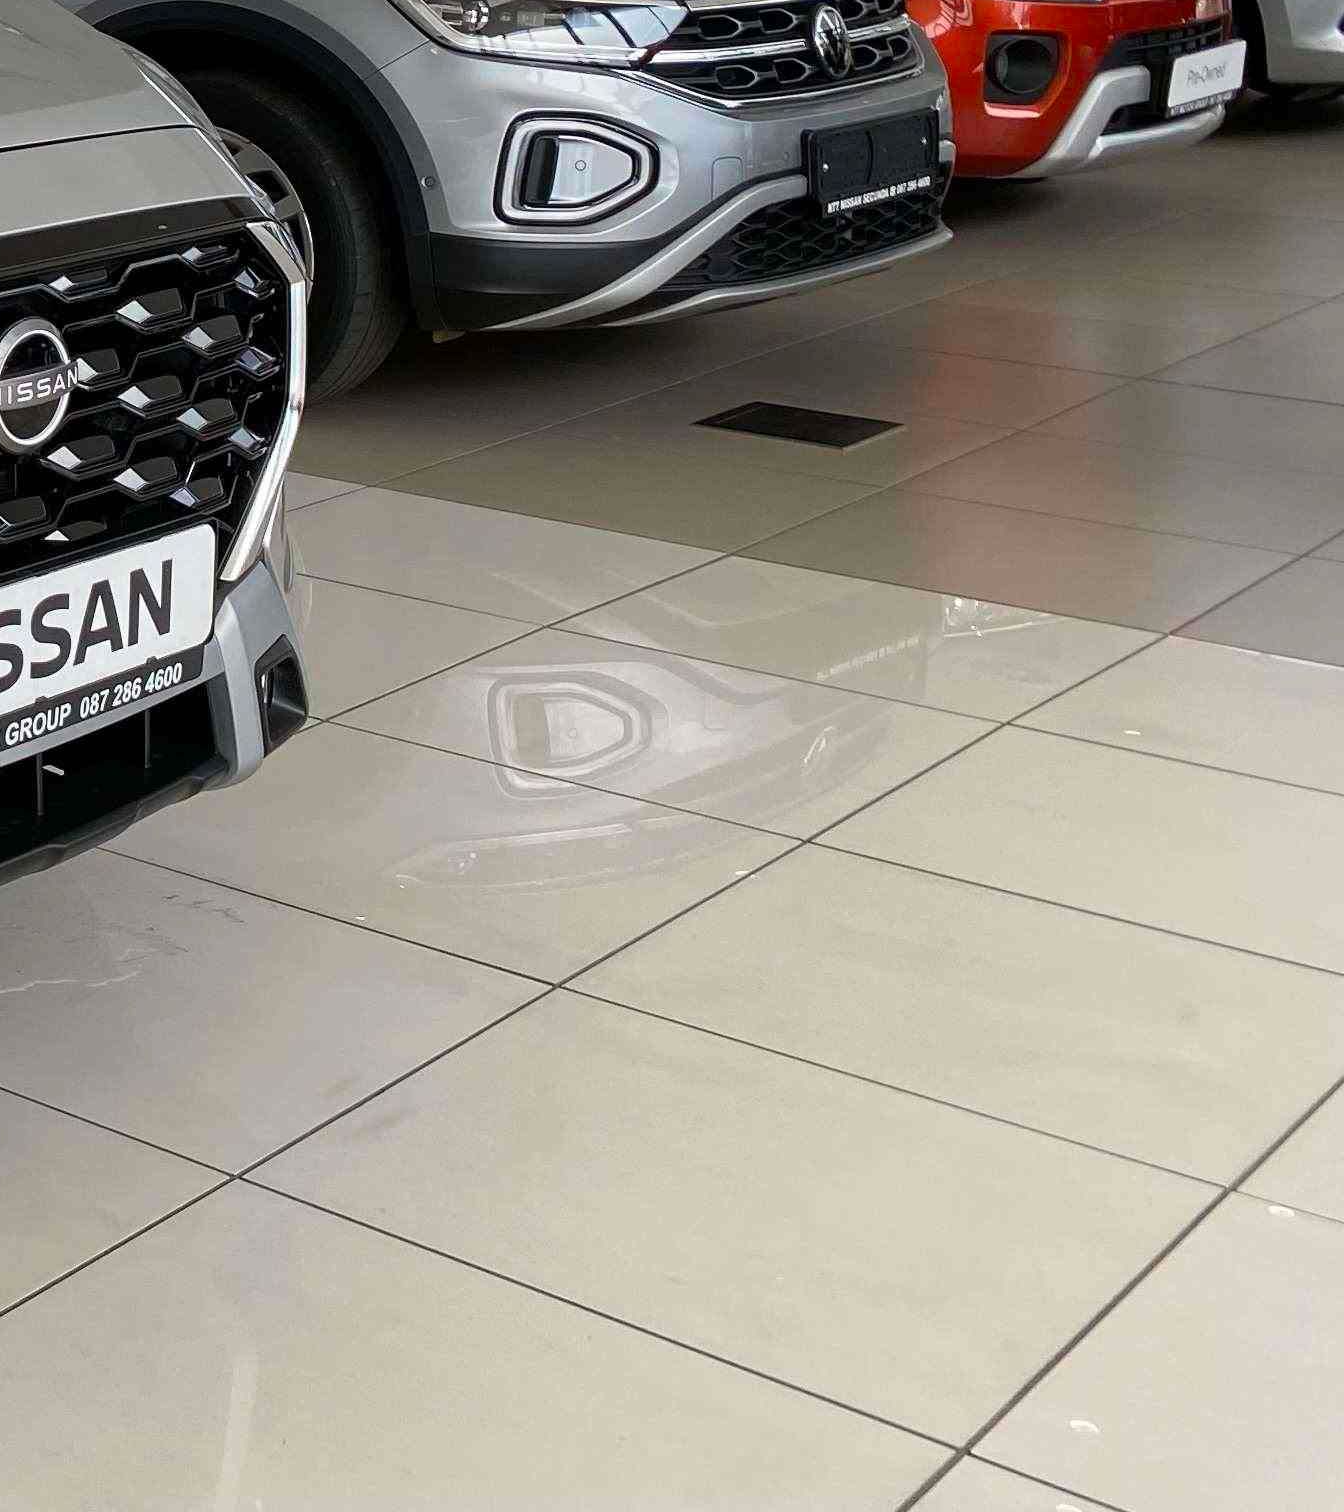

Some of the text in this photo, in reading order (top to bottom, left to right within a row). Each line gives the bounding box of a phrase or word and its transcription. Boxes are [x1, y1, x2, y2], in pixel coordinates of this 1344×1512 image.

[6, 703, 73, 747] GROUP
[79, 691, 109, 720] 087
[111, 677, 143, 709] 286
[144, 661, 184, 698] 4600
